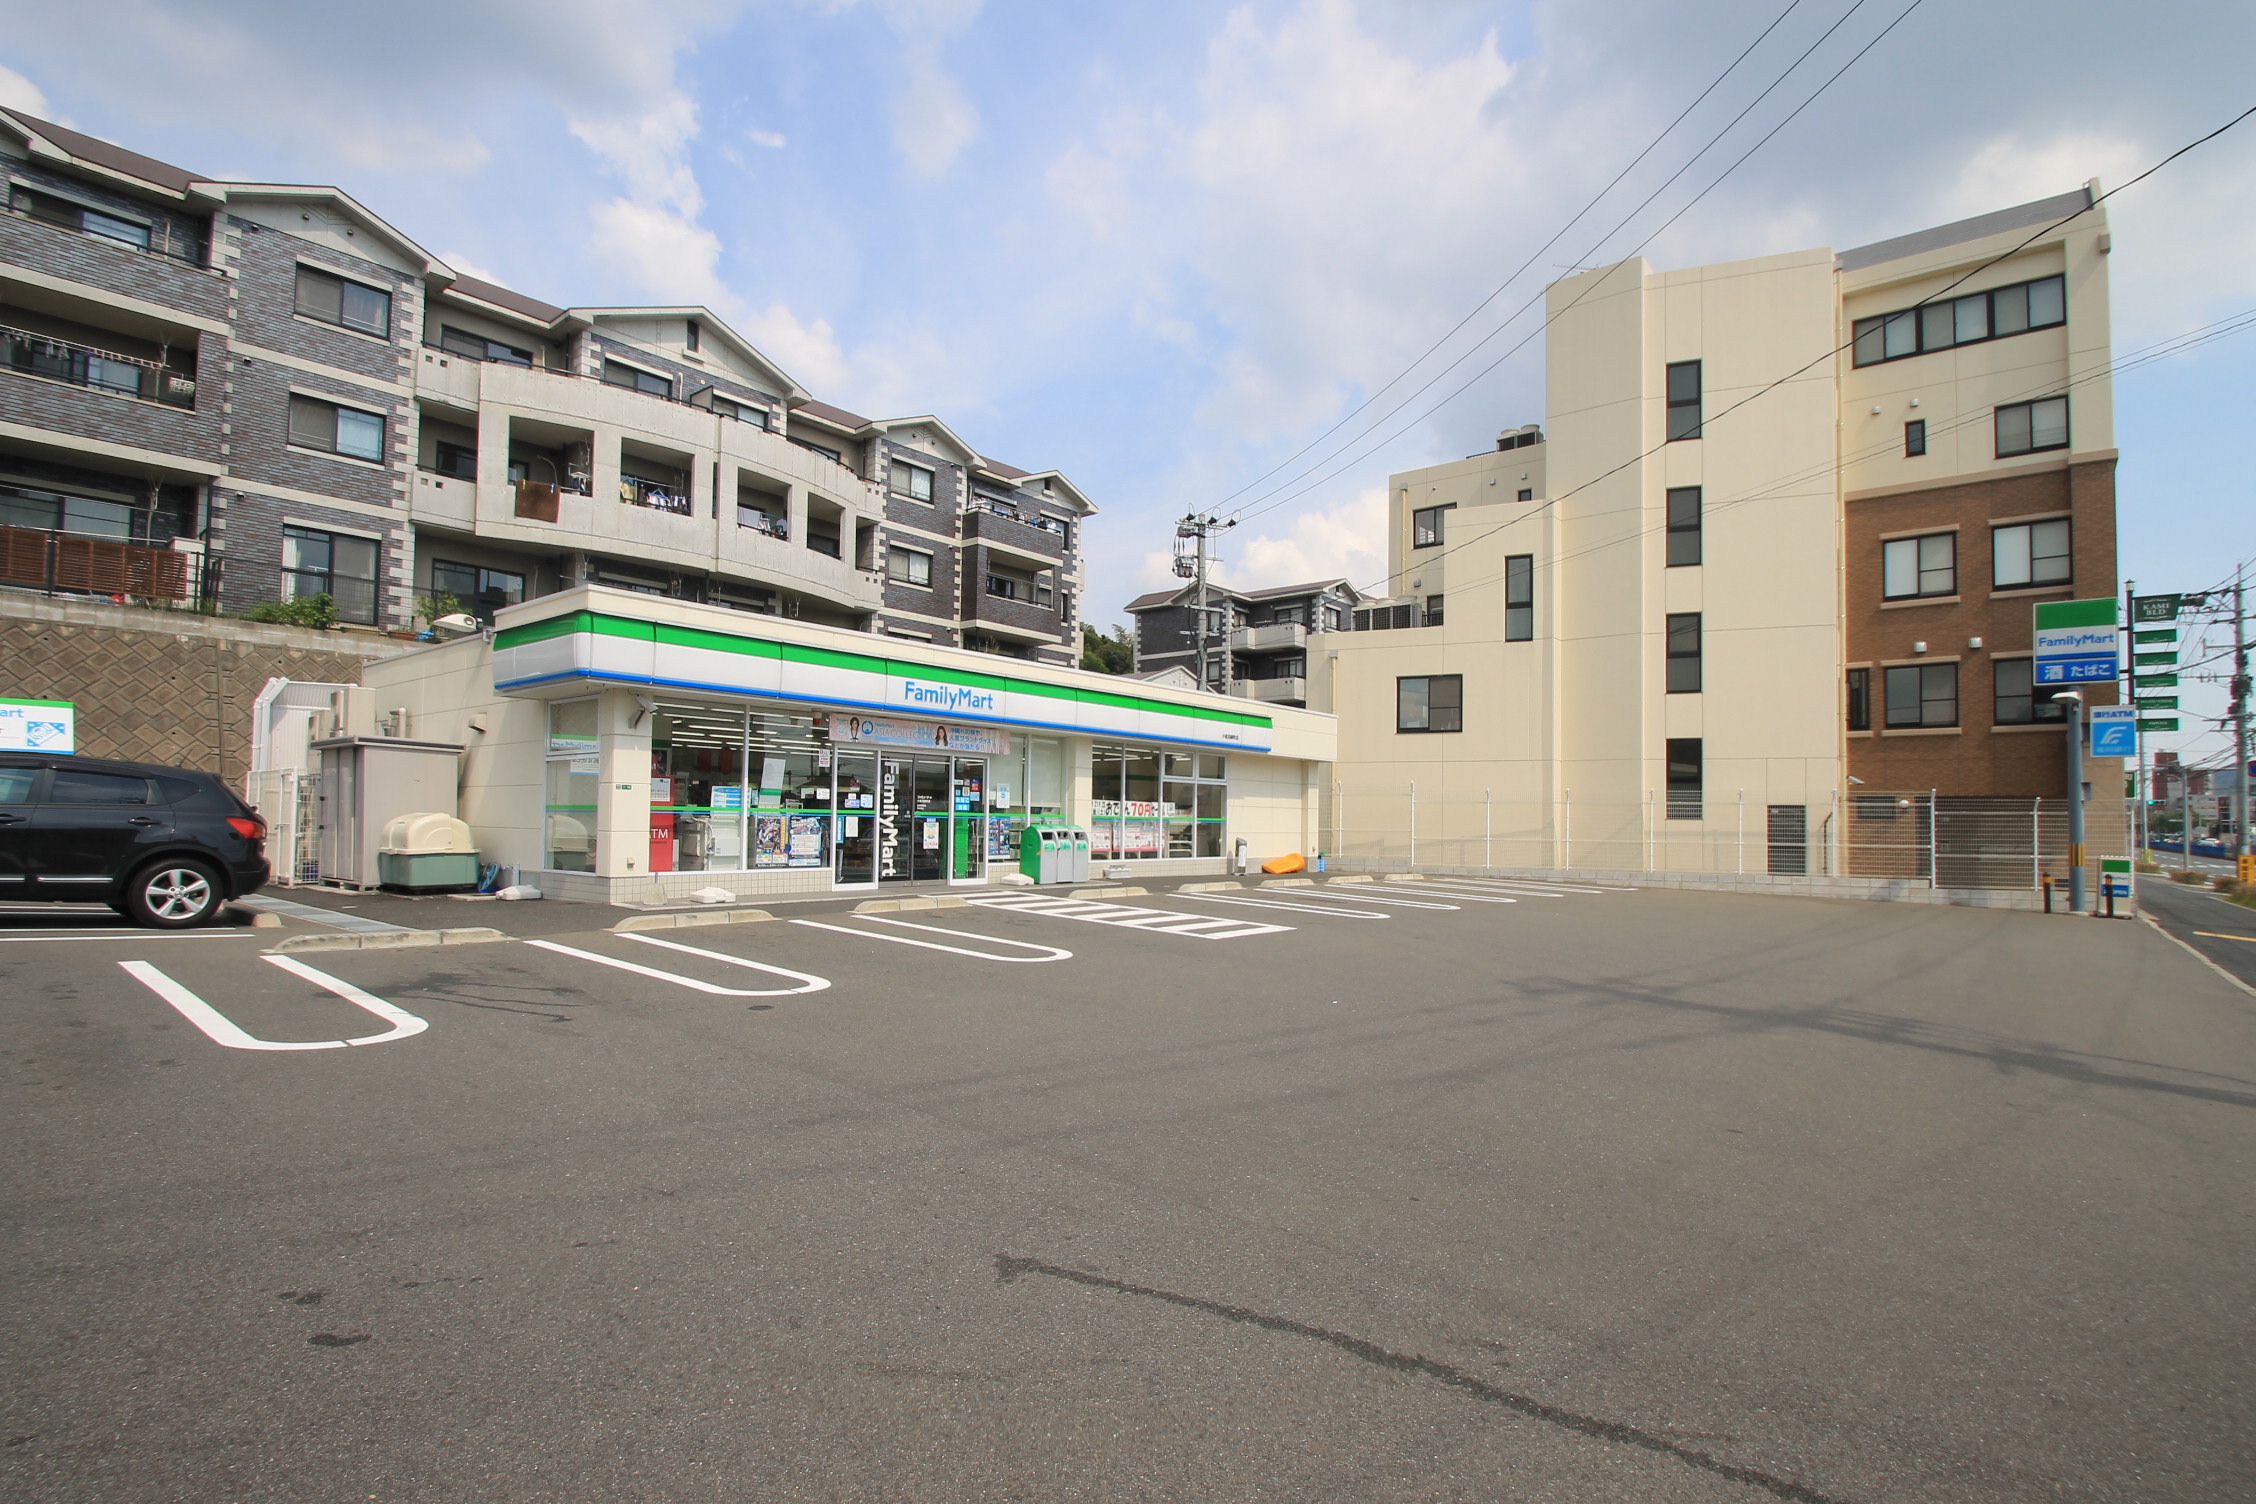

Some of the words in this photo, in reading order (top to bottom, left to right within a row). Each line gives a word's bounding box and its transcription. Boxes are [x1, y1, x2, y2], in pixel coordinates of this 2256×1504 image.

[2038, 634, 2115, 647] FamilyMart
[2044, 665, 2064, 680] 酒
[2070, 664, 2111, 677] たばこ
[904, 681, 993, 710] FamilyMart
[880, 761, 899, 877] FamilyMart
[650, 828, 668, 839] TM
